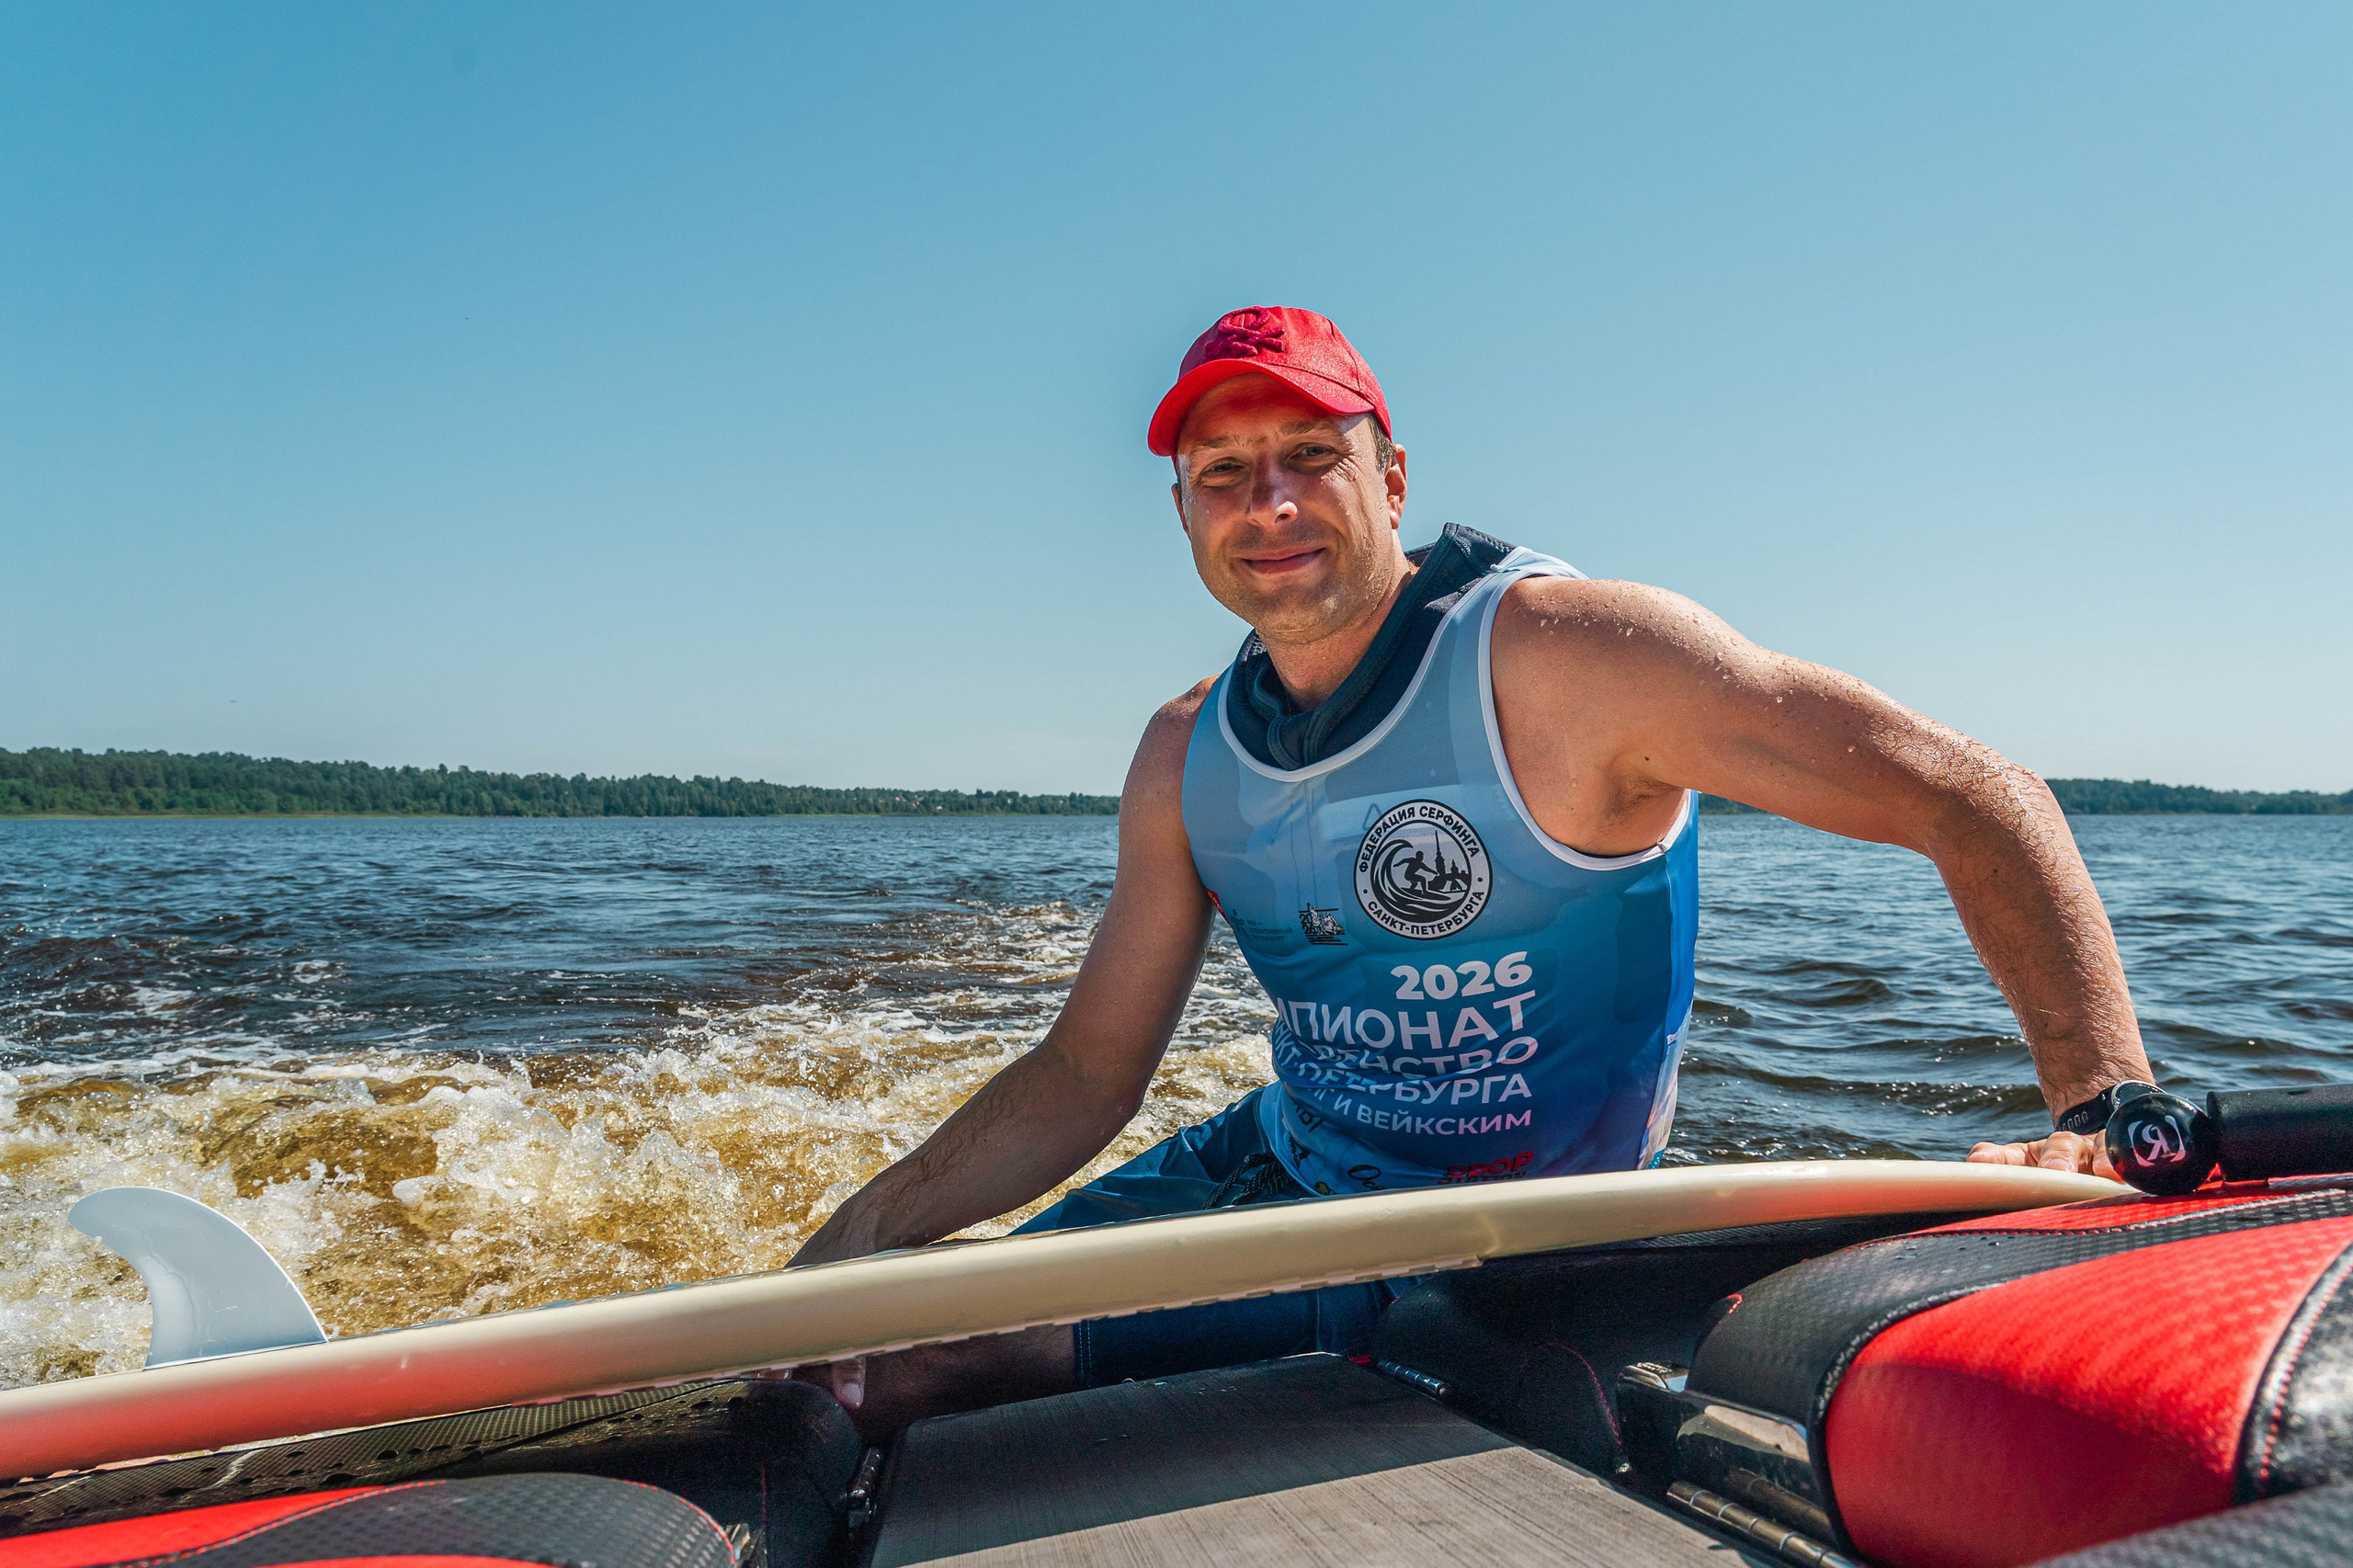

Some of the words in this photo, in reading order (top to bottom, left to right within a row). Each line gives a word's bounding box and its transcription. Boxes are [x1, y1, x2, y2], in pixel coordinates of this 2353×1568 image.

[1359, 807, 1415, 872] ФЕДЕРАЦИЯ
[1419, 806, 1480, 858] СЕРФИНГА
[1368, 891, 1484, 935] САНКТ-ПЕТЕРБУРГА
[1391, 951, 1532, 1000] 2026
[1357, 1104, 1531, 1135] ВЕЙКСКИМ
